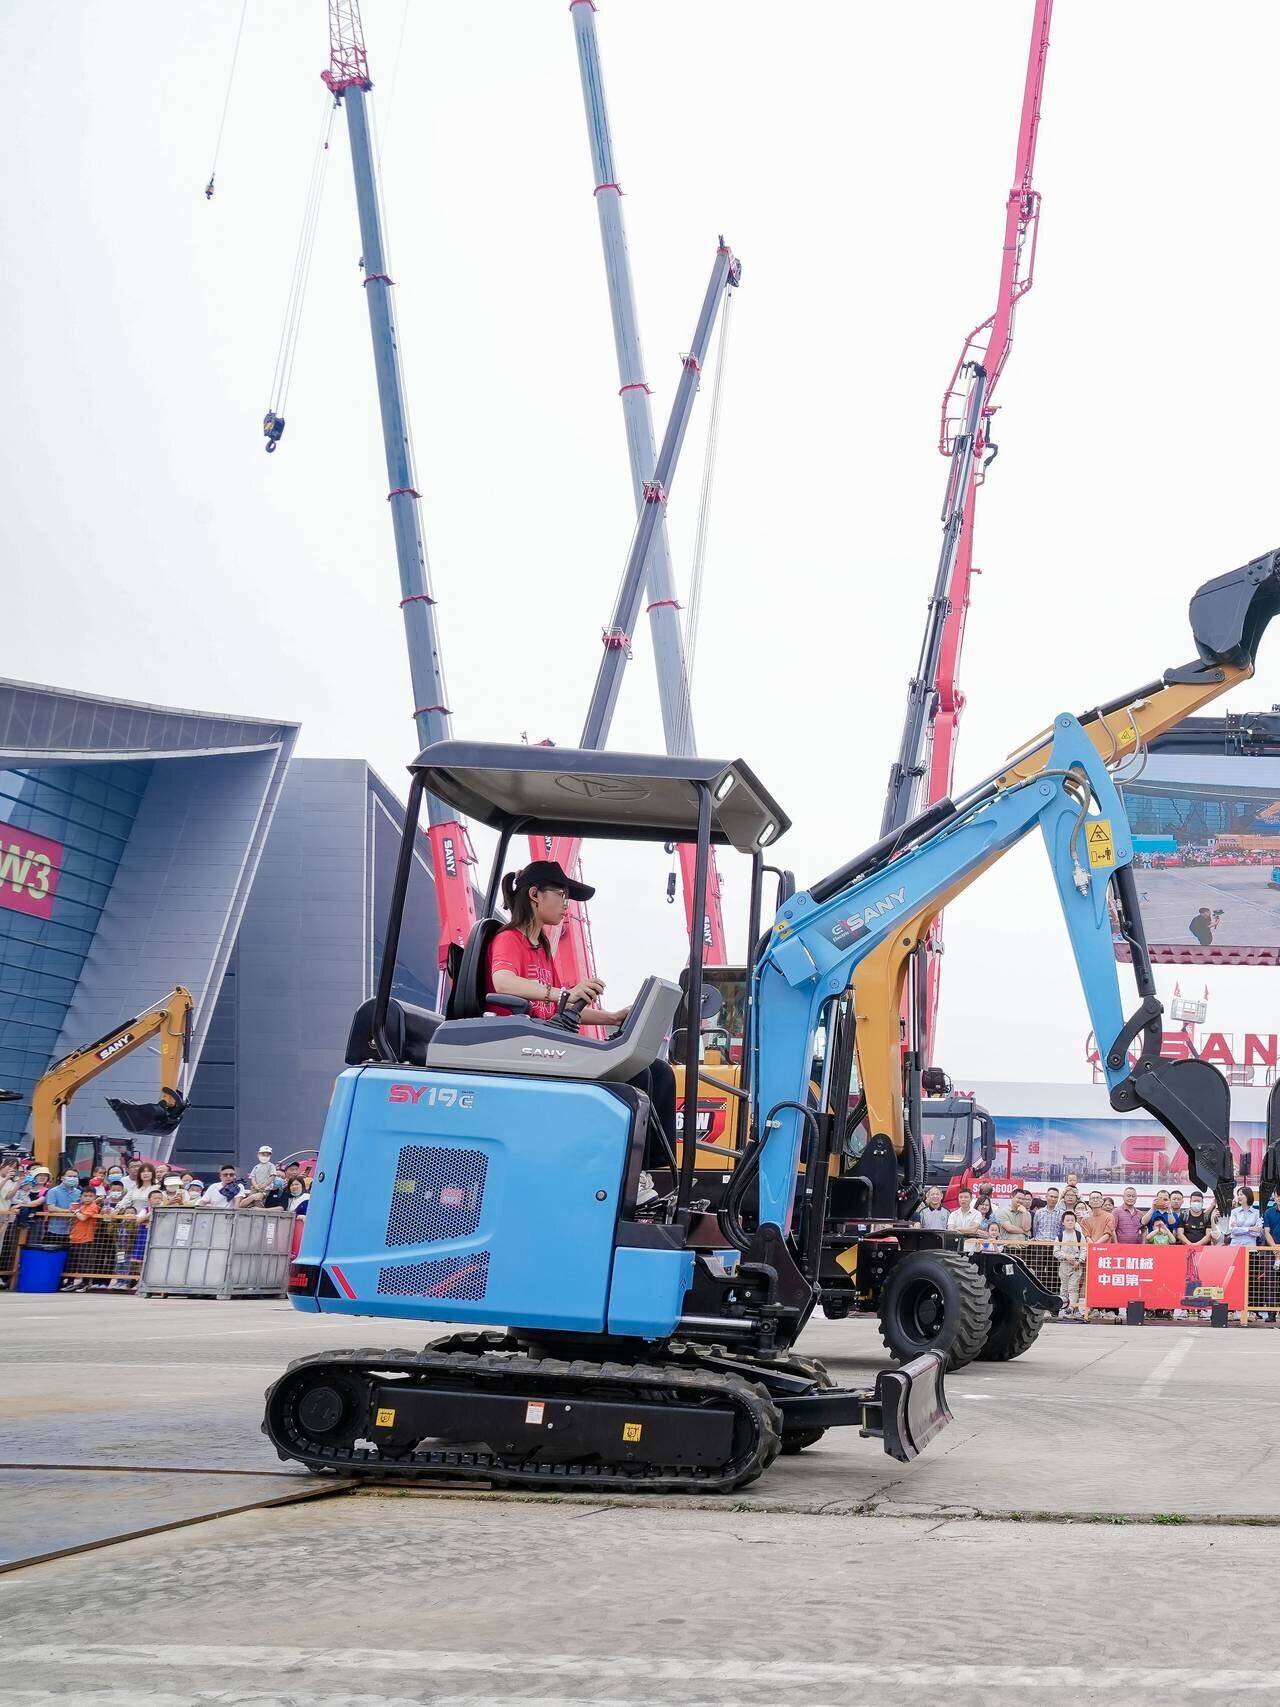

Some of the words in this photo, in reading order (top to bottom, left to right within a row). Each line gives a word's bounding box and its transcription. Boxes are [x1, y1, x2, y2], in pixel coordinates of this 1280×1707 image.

[0, 842, 51, 899] W3
[443, 839, 457, 876] SANY
[846, 887, 905, 932] SANY
[100, 1033, 130, 1059] SANY
[521, 1047, 566, 1058] SANY
[1098, 1256, 1154, 1270] 桩工机械
[1098, 1273, 1153, 1287] 中国第一
